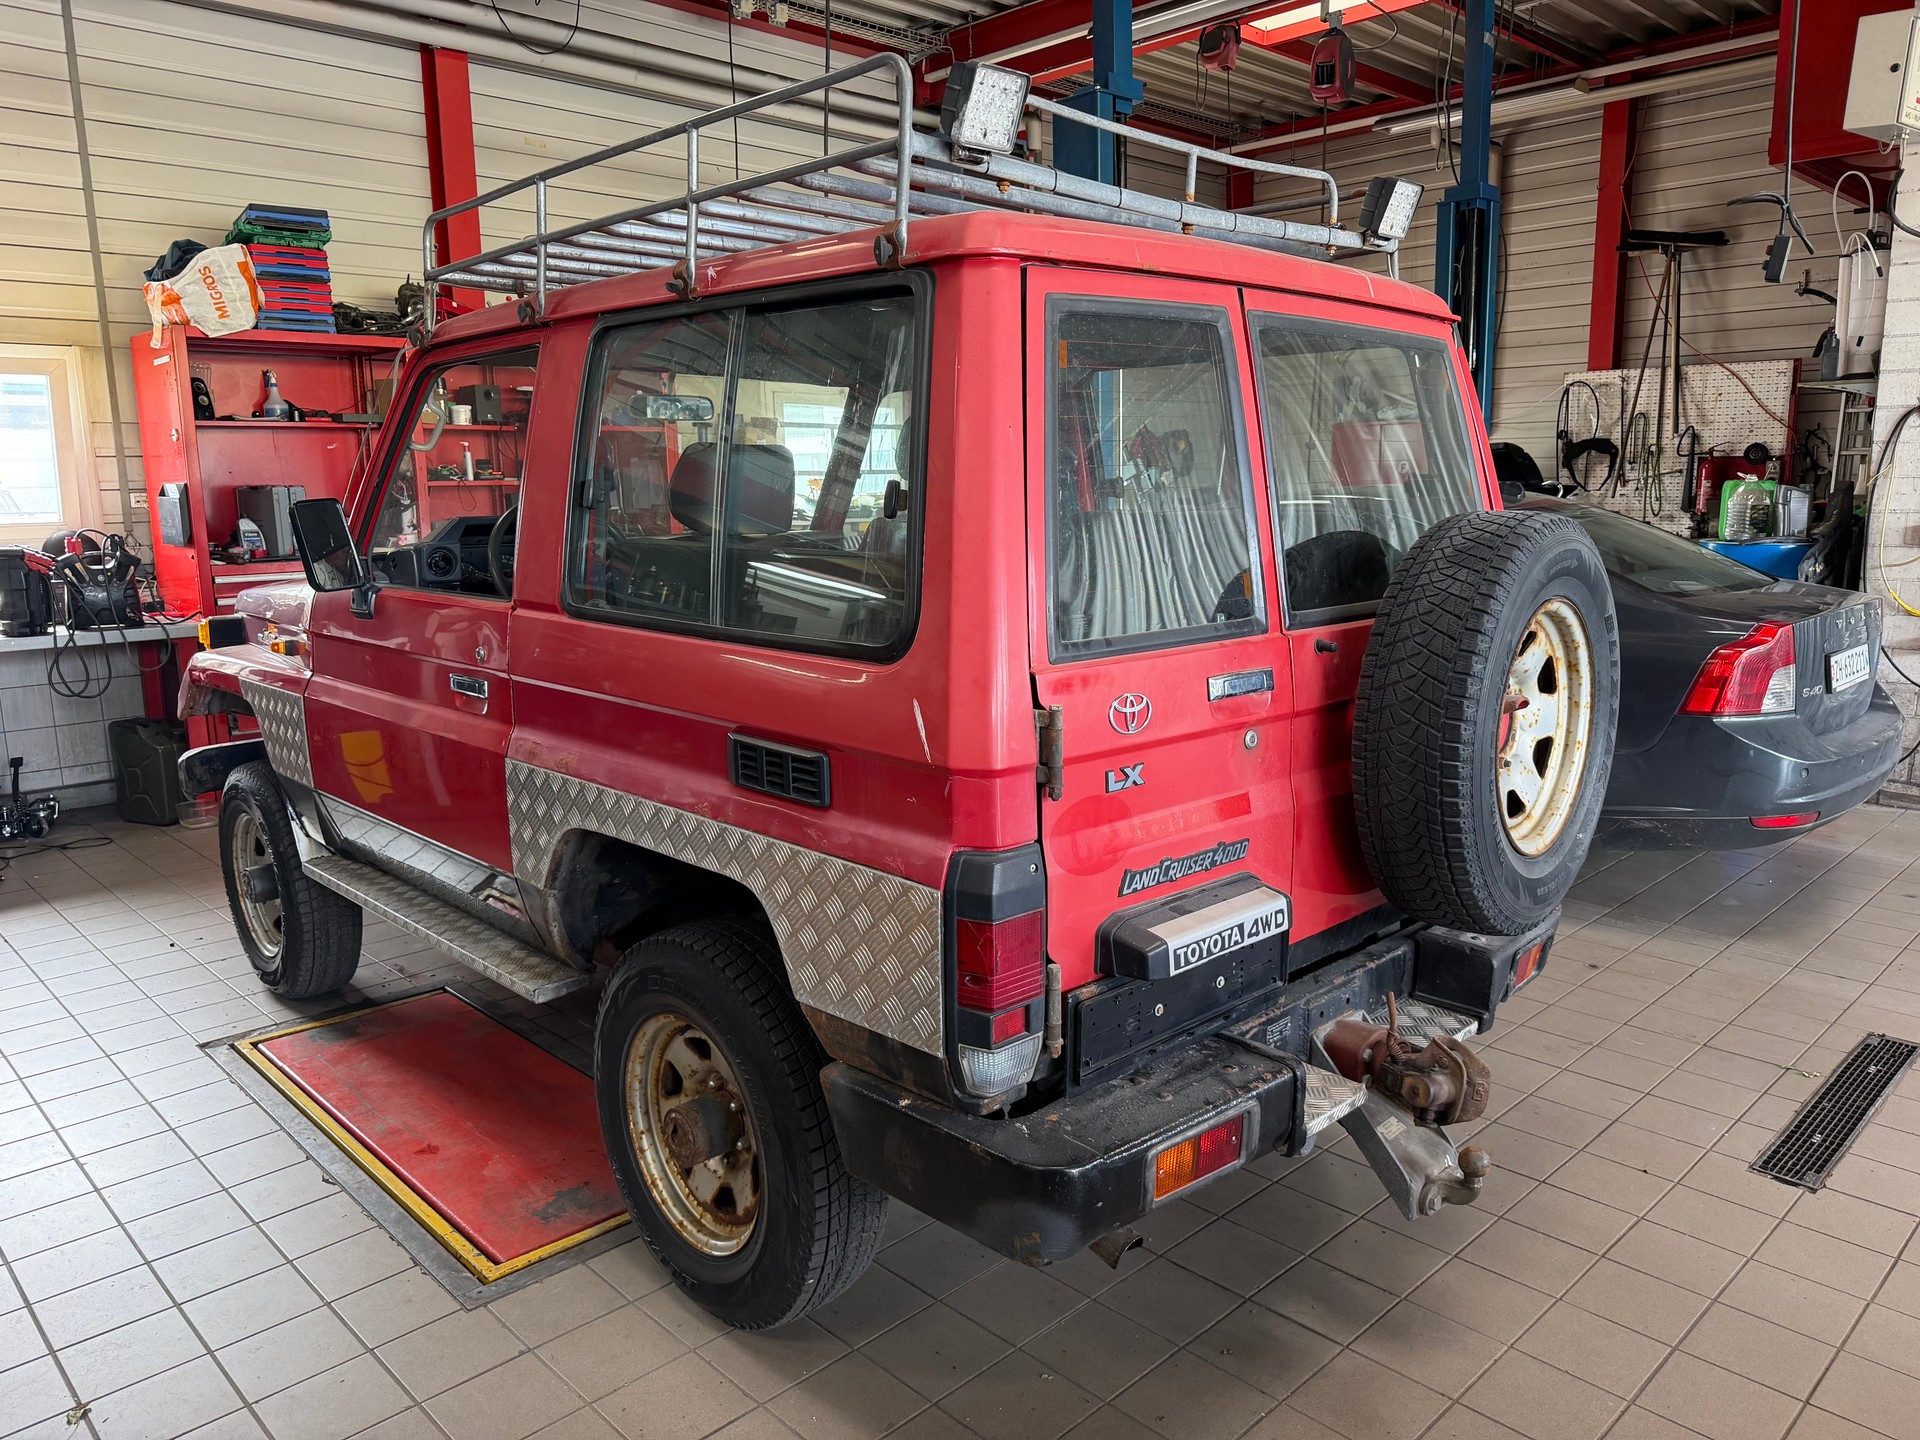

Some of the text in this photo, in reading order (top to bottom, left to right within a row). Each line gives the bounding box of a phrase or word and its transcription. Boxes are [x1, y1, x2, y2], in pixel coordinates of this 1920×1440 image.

[198, 265, 231, 320] MIGROS
[1802, 685, 1823, 698] S40
[1105, 762, 1145, 793] LX
[1214, 841, 1250, 866] 4000
[1175, 908, 1286, 967] TOYOTA 4WD
